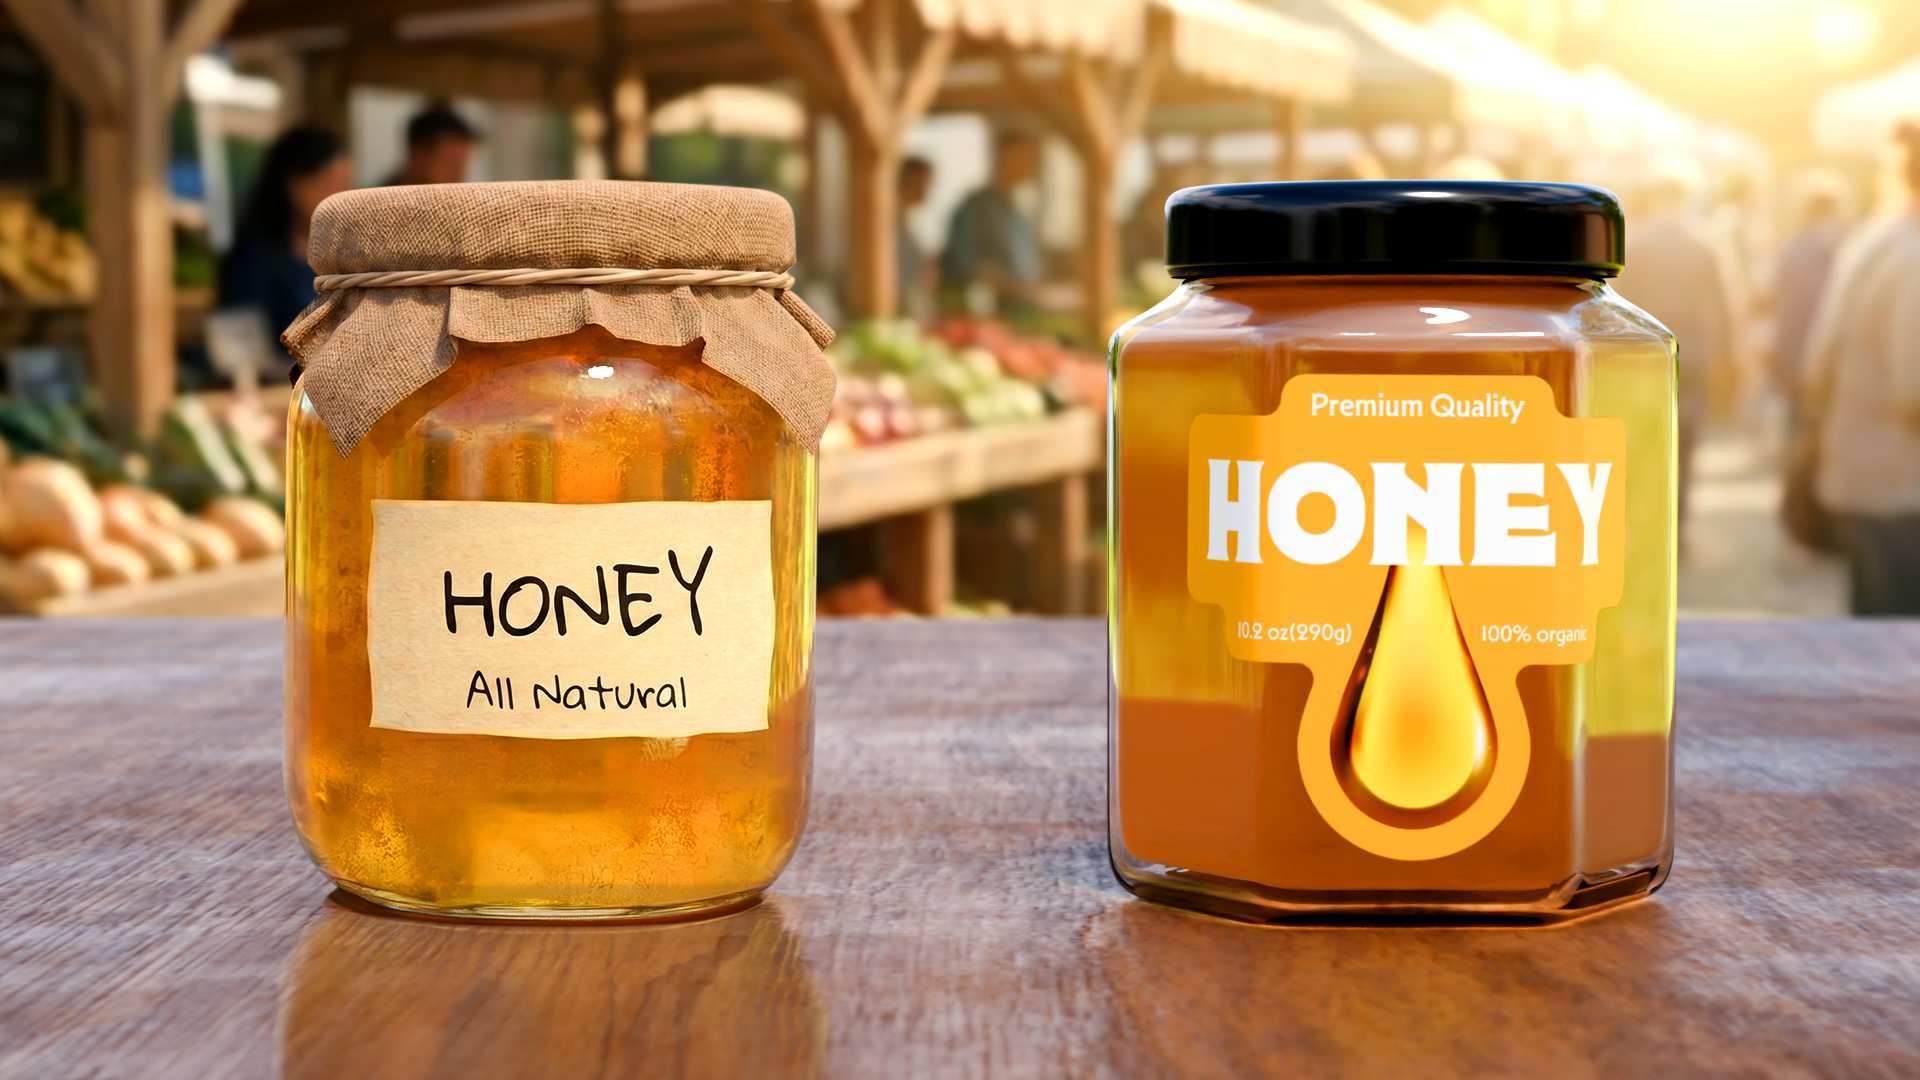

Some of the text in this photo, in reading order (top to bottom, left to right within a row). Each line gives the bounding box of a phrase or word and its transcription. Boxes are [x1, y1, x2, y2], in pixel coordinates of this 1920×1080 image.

[1311, 392, 1525, 424] Premium Quality
[1206, 459, 1613, 567] HONEY
[443, 546, 713, 637] HONEY
[1237, 621, 1352, 645] 10.2 oz(290g)
[1481, 625, 1532, 642] 100%
[466, 670, 687, 710] All Natural
